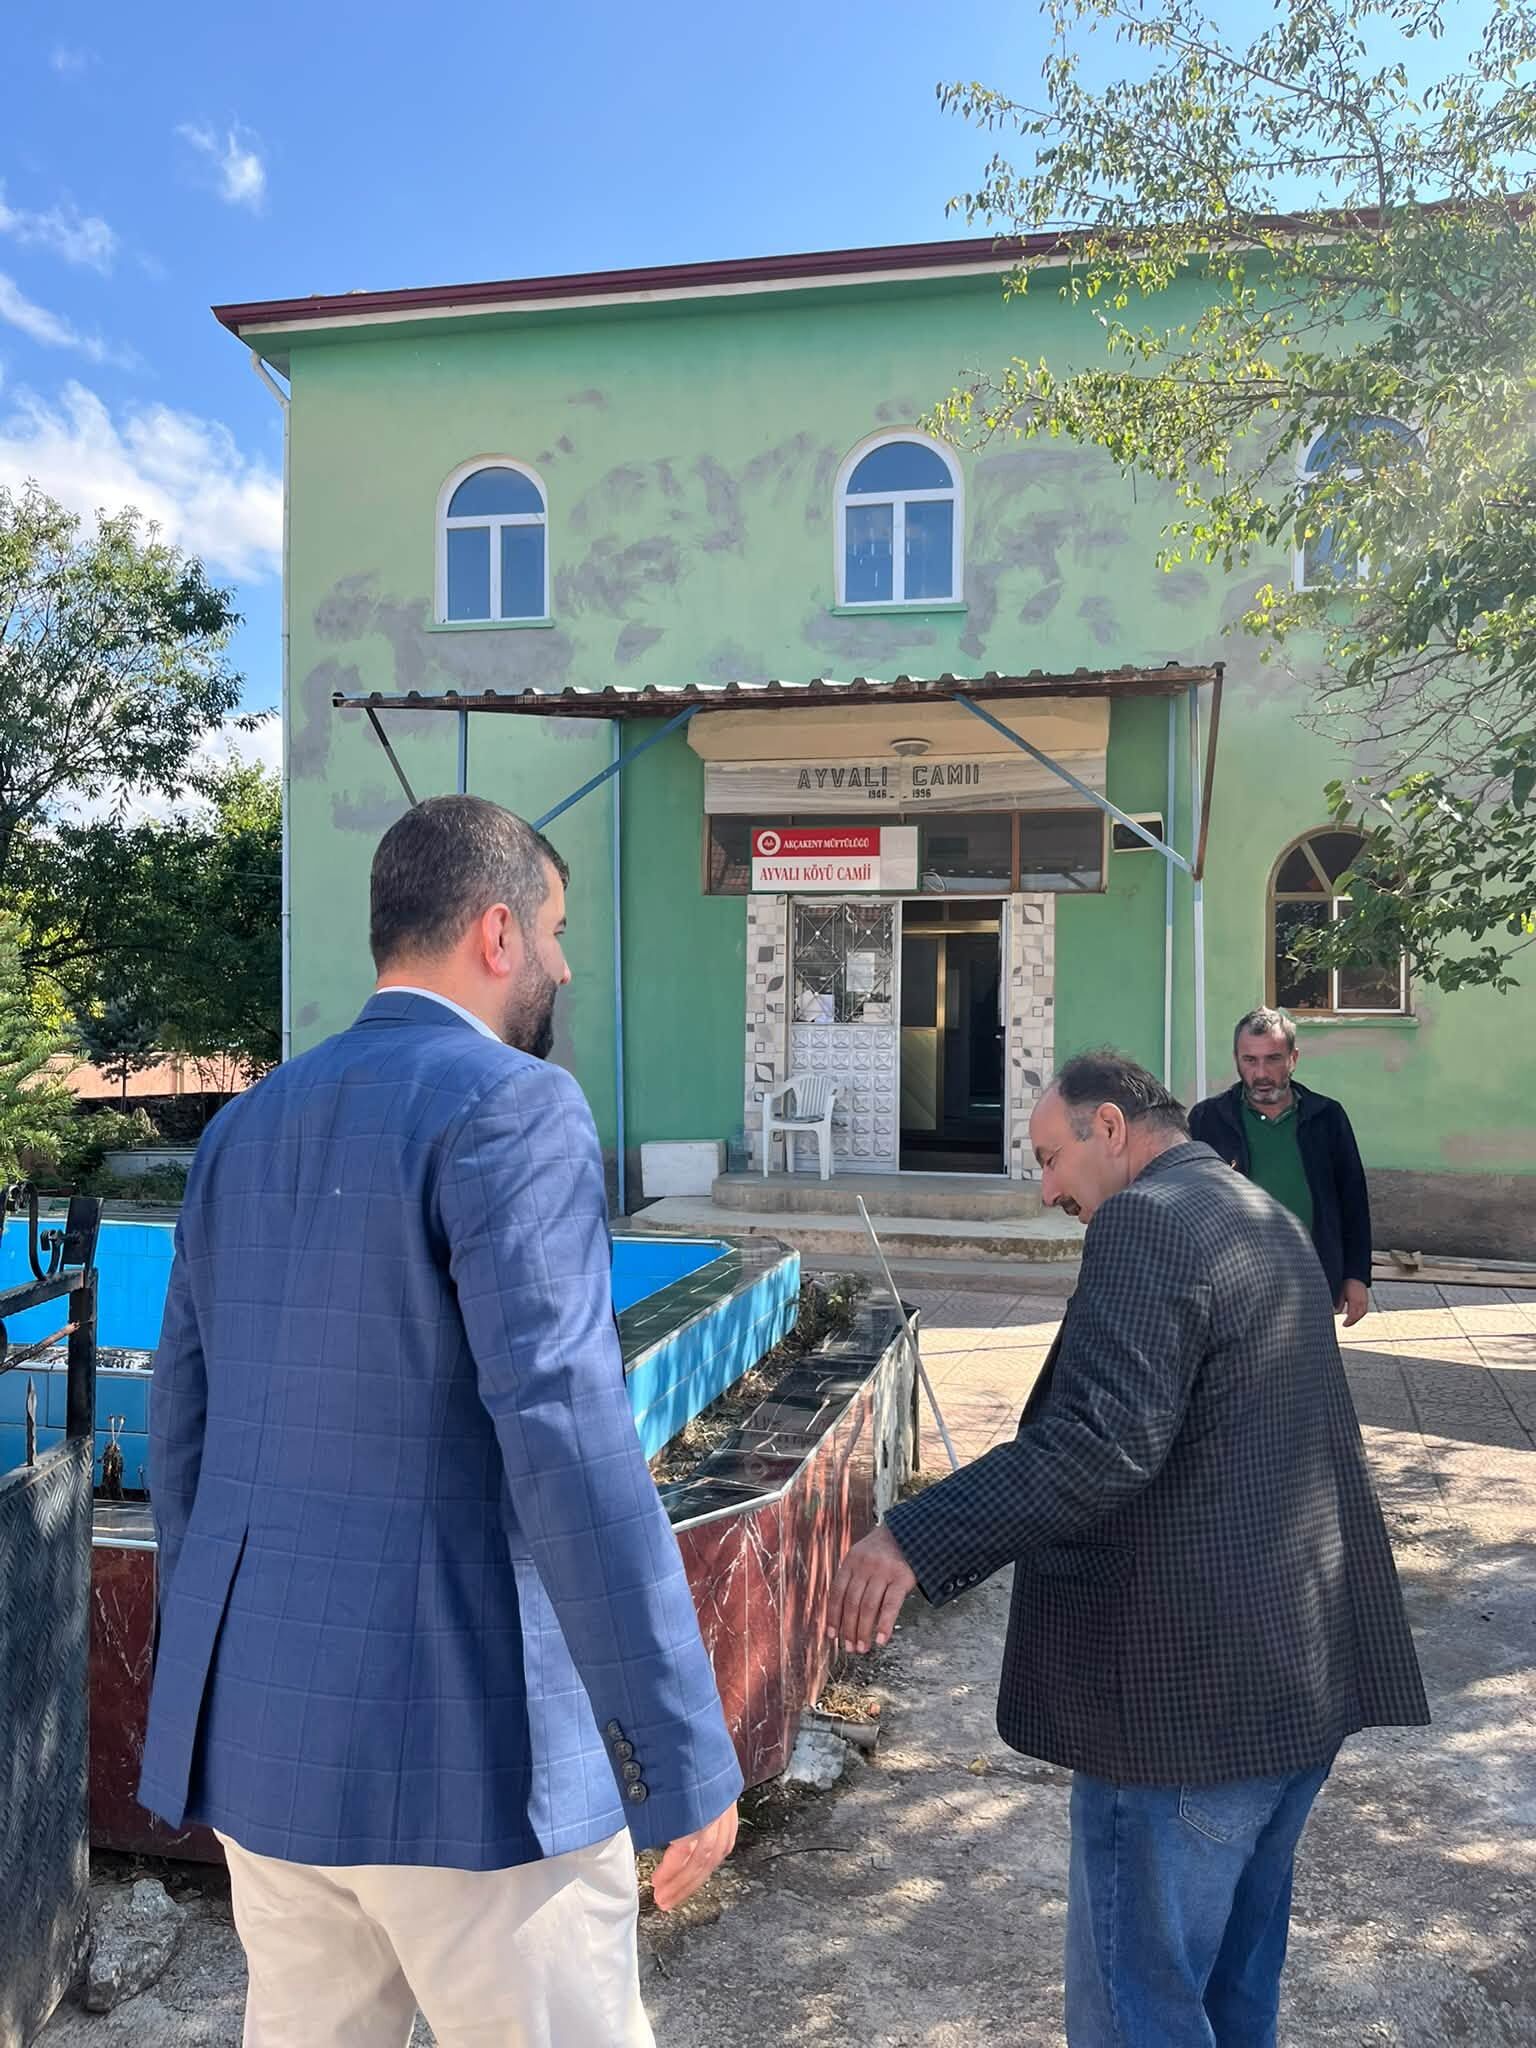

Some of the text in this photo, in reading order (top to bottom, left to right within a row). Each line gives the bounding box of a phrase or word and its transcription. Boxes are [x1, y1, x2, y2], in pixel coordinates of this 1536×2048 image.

[798, 767, 888, 789] AYVALI
[783, 837, 870, 850] AKÇAKENT MÜFTÜLÜĞÜ
[760, 863, 871, 881] AYVALI KÖYÜ CAMİİ
